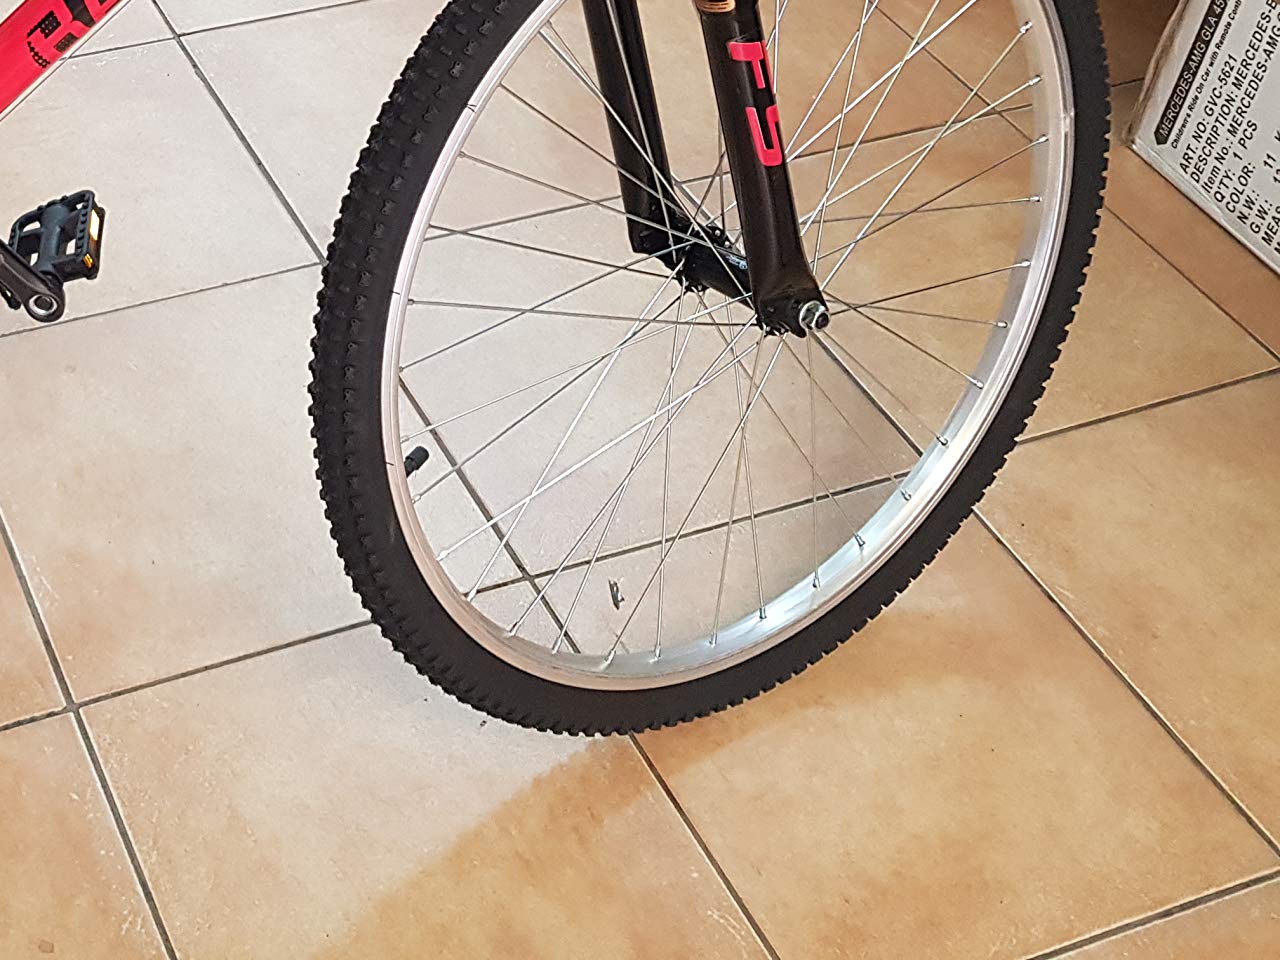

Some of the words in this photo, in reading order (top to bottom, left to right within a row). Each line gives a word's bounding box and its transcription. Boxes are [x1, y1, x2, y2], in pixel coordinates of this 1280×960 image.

[1158, 40, 1205, 138] MERCEDES-AMG
[1201, 13, 1218, 42] GLA
[1186, 93, 1199, 112] Ride
[1195, 81, 1204, 95] On
[1200, 66, 1211, 82] Car
[1206, 49, 1218, 67] with
[1214, 19, 1232, 51] Remote
[1178, 141, 1198, 174] ART.
[1191, 116, 1209, 143] NO:
[1203, 52, 1238, 118] GVC-5621
[1189, 87, 1238, 184] DESCRIPTION:
[1201, 162, 1221, 194] Item
[1212, 166, 1236, 204] Q'TY:
[1232, 150, 1242, 161] 1
[1237, 118, 1258, 150] PCS
[1224, 159, 1256, 215] COLOR:
[1236, 187, 1259, 225] N.W.:
[1261, 151, 1276, 170] 11
[1248, 196, 1272, 236] G.W.:
